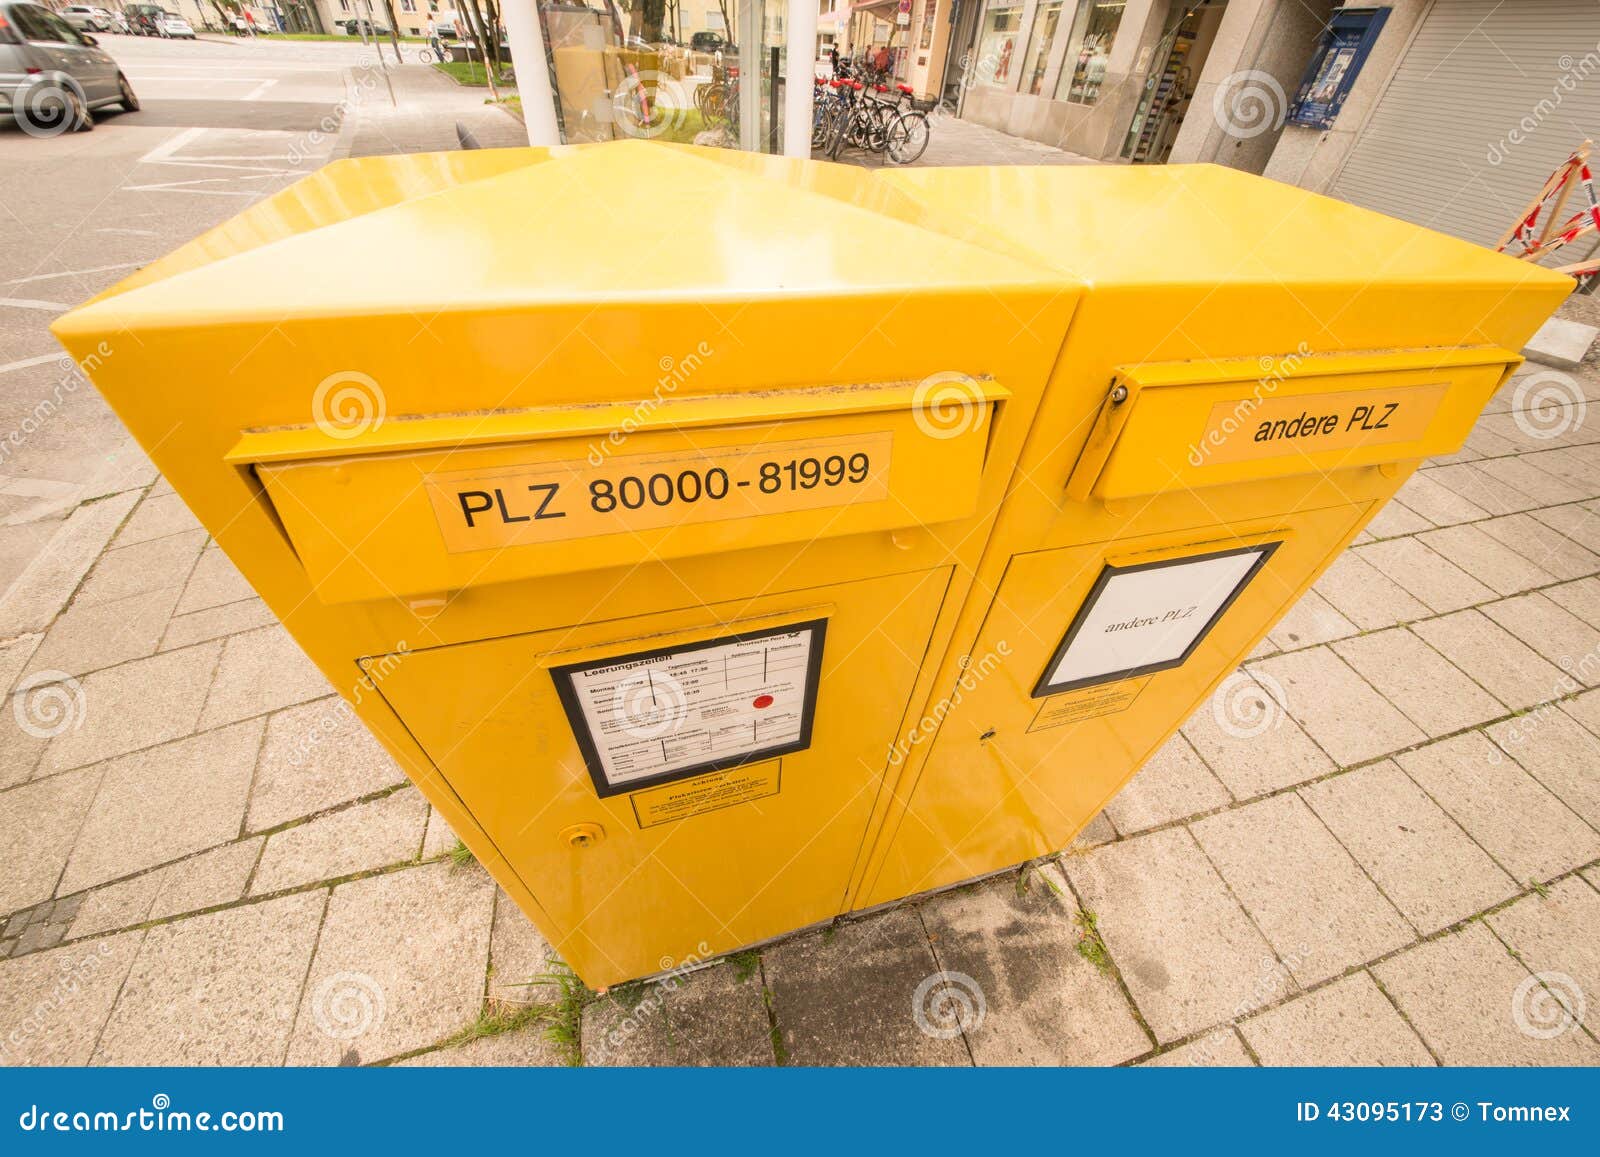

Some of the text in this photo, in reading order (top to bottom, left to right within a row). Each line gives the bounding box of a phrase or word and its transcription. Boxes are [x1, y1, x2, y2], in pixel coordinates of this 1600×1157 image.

[1254, 402, 1400, 442] andere PLZ
[457, 482, 566, 528] PLZ
[1104, 606, 1198, 633] andere PLZ
[583, 654, 673, 678] Leerungszeiten
